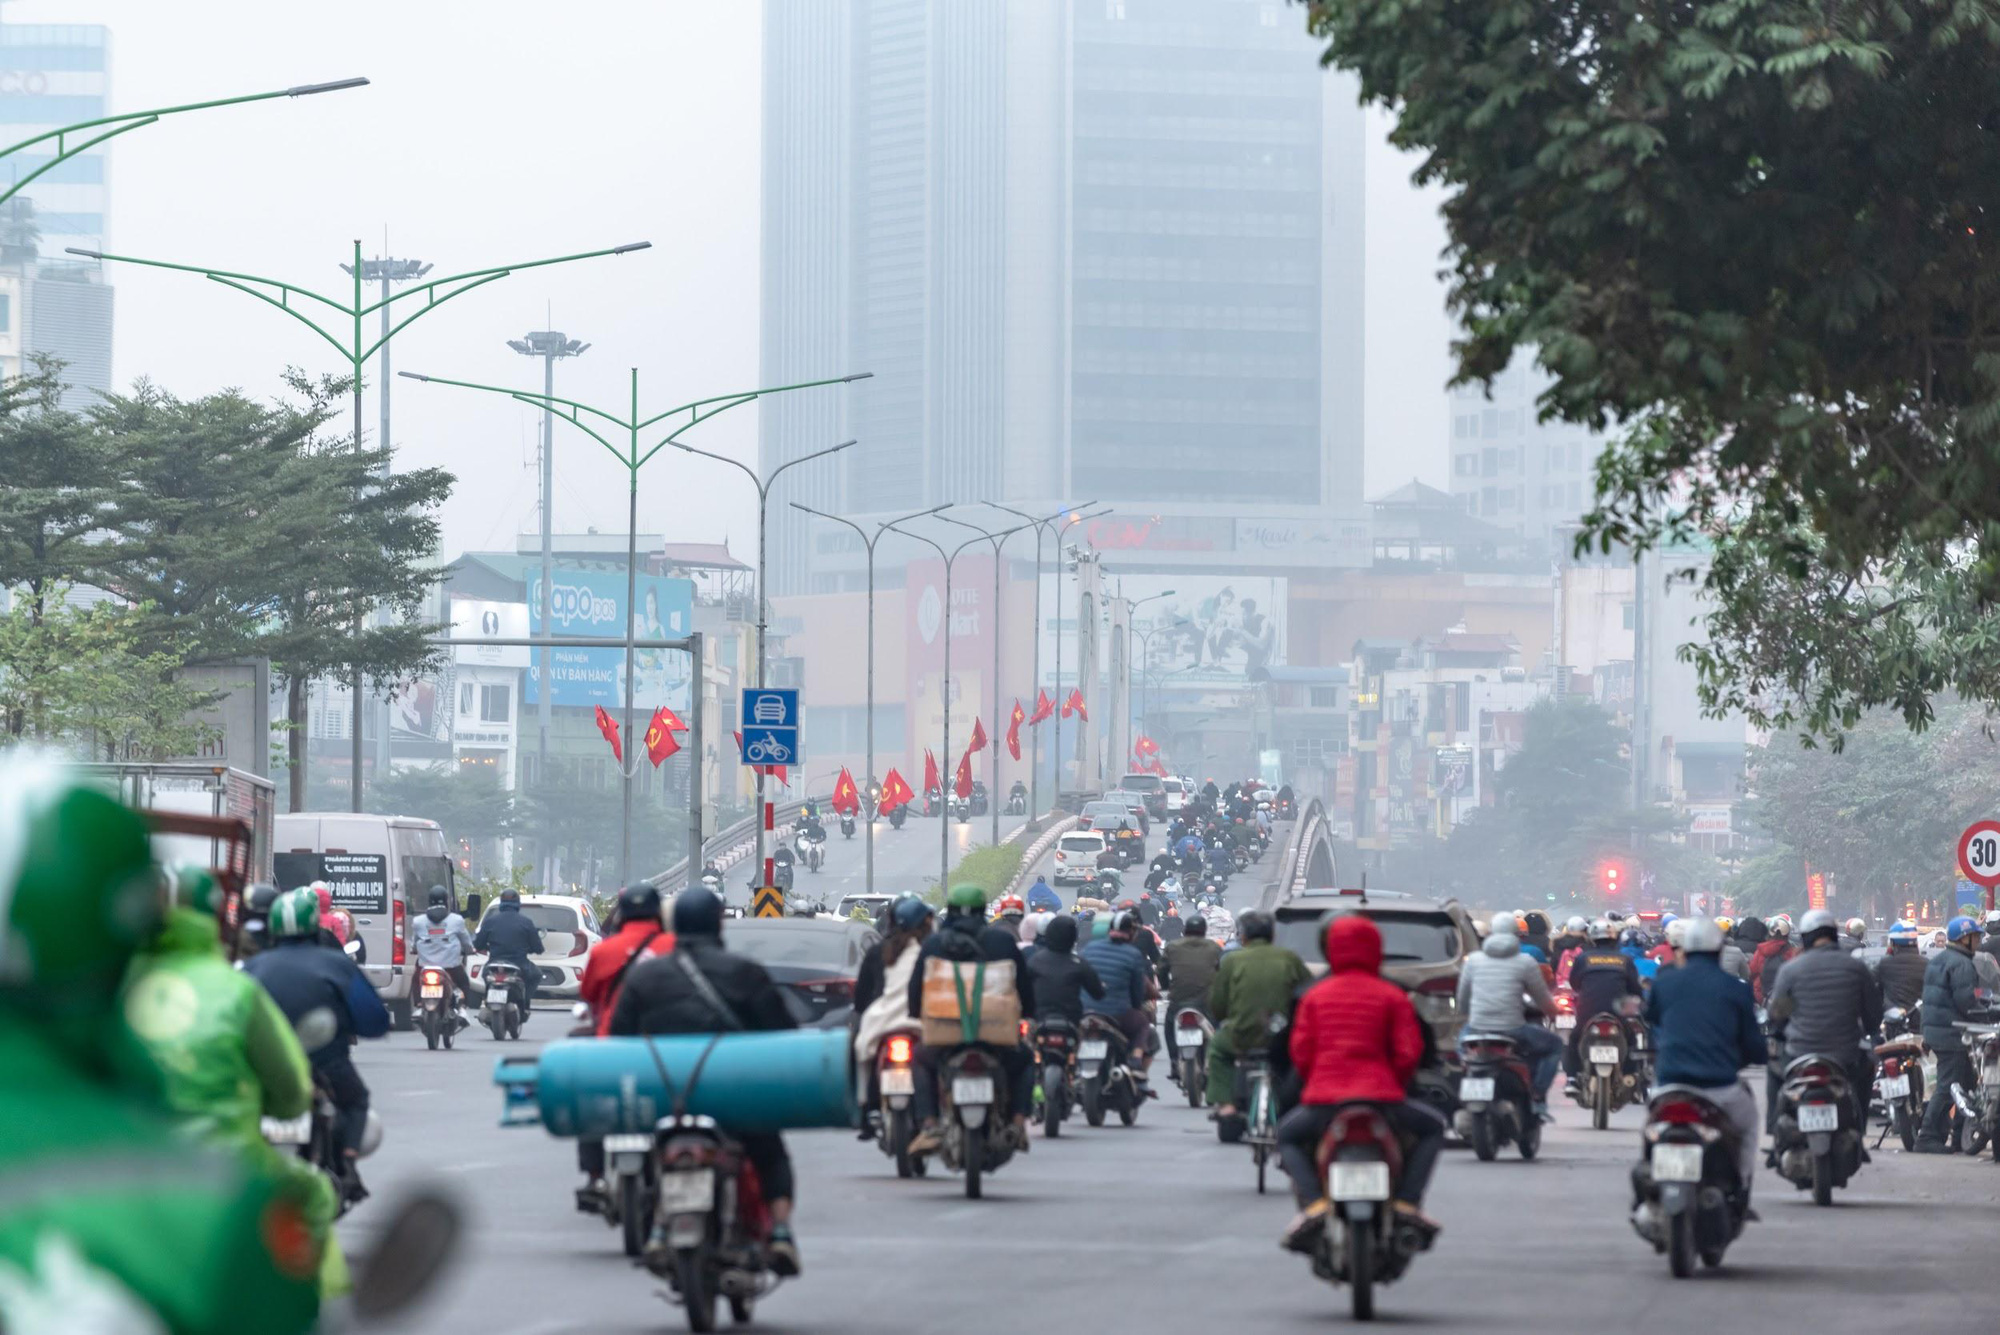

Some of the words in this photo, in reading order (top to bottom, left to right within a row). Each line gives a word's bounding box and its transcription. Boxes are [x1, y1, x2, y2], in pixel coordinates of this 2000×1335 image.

[950, 587, 981, 606] OTTE
[557, 665, 567, 680] LÝ
[568, 666, 587, 682] BÁN
[588, 667, 613, 682] HÀNG
[1972, 838, 1996, 867] 30
[336, 877, 355, 897] ĐỒNG
[356, 881, 365, 896] DU
[366, 881, 384, 898] LỊCH
